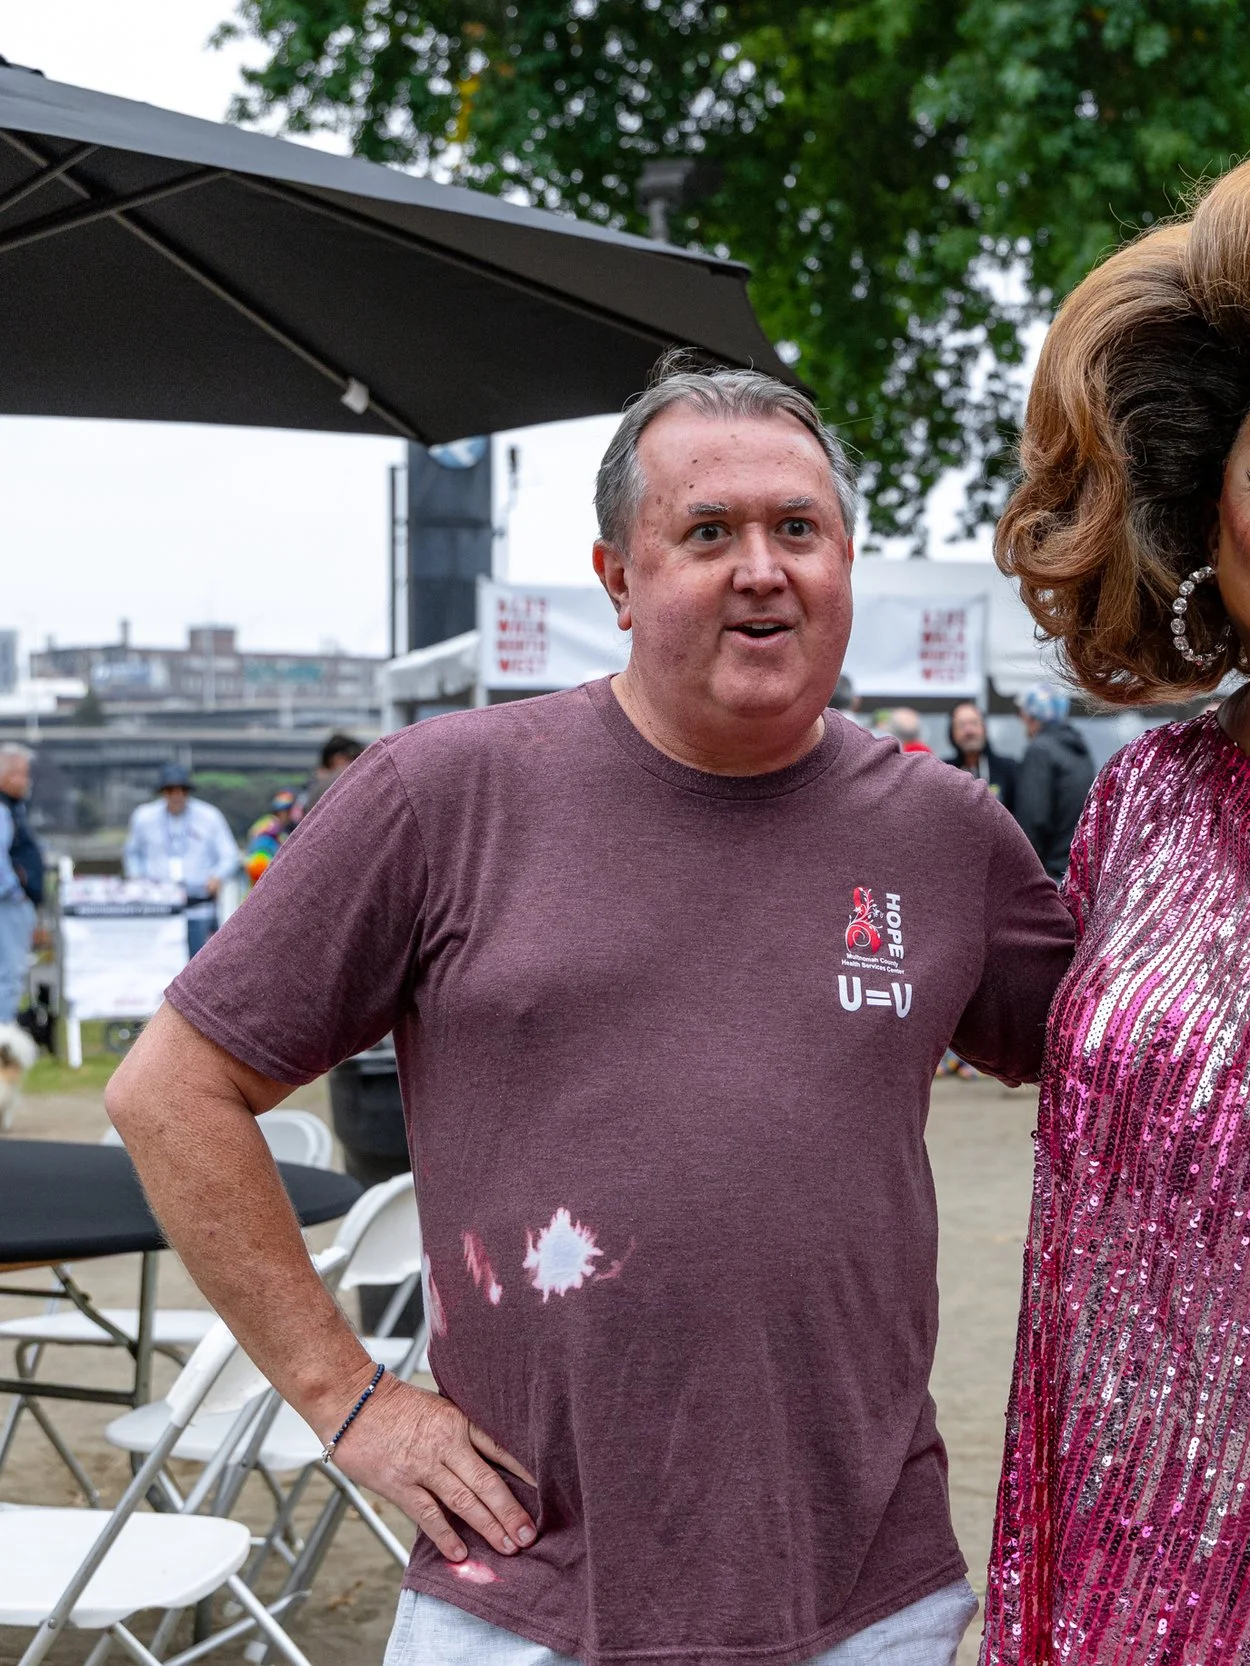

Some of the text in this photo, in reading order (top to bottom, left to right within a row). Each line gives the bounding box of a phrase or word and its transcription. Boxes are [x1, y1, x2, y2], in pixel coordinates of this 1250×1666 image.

[885, 892, 905, 960] HOPE
[841, 959, 905, 974] Health Services Center
[880, 958, 898, 968] County
